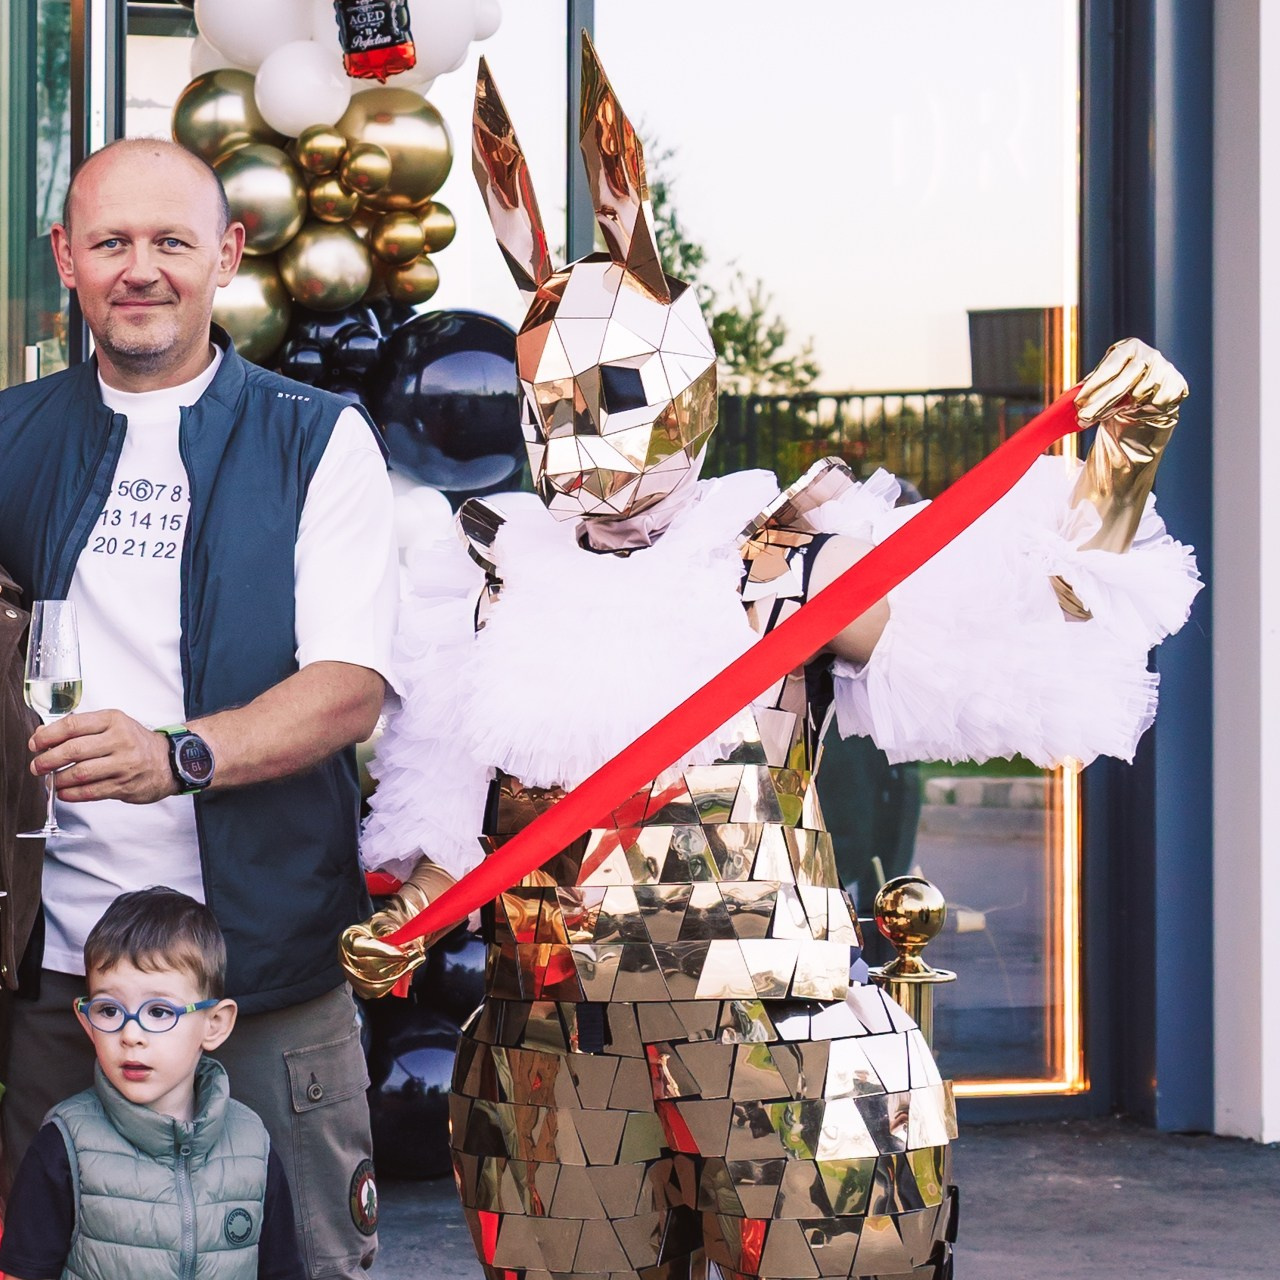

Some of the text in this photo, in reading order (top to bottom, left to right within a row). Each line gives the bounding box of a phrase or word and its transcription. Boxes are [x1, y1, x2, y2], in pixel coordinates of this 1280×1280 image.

[349, 10, 386, 26] AGED
[351, 34, 392, 51] Perfection
[117, 480, 183, 503] 5 6 7 8
[101, 509, 184, 531] 13 14 15
[93, 536, 177, 559] 20 21 22
